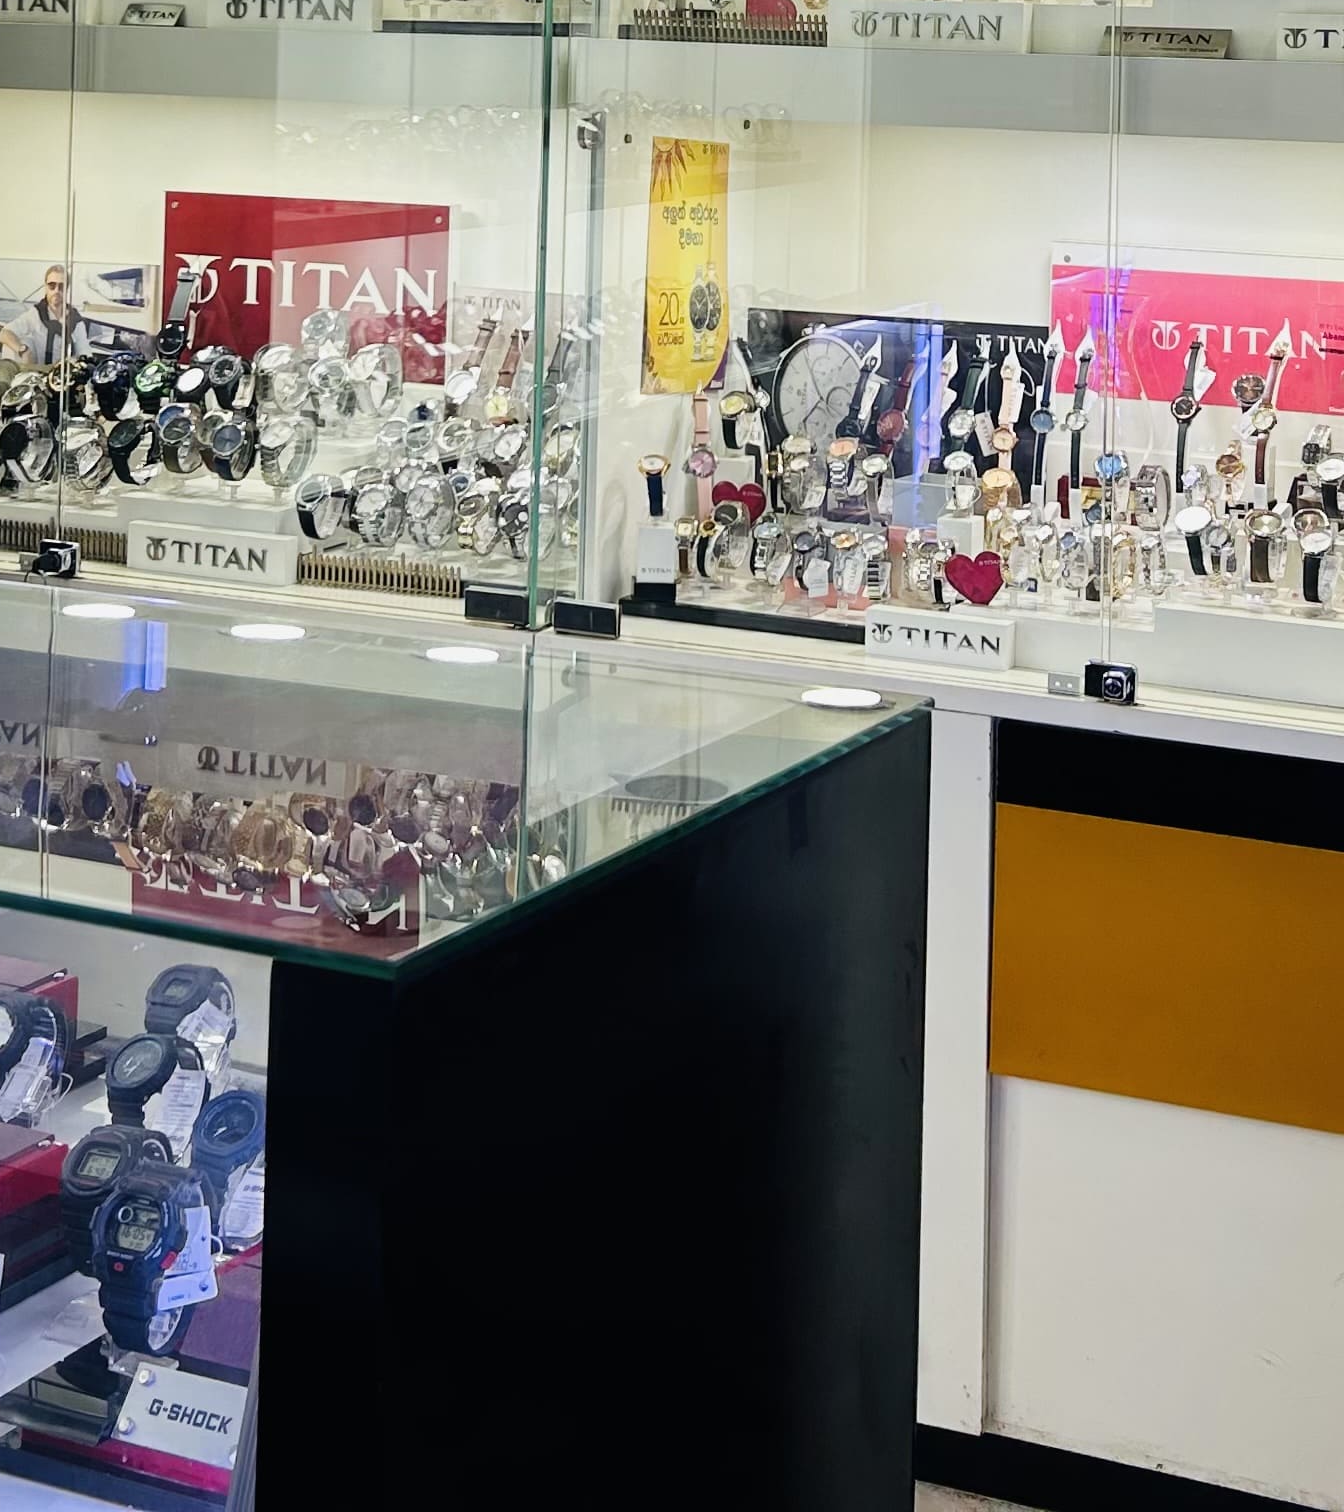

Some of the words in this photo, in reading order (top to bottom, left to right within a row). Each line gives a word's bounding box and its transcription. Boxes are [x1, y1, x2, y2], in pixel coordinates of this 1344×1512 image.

[139, 9, 176, 21] TITAN
[882, 12, 1002, 41] TITAN
[1139, 31, 1213, 46] TITAN
[229, 258, 438, 316] TITAN
[481, 296, 521, 310] TITAN
[1189, 321, 1326, 361] TITAN
[172, 543, 268, 573] TITAN
[900, 627, 1000, 656] TITAN
[148, 1397, 234, 1435] G-SHOCK
